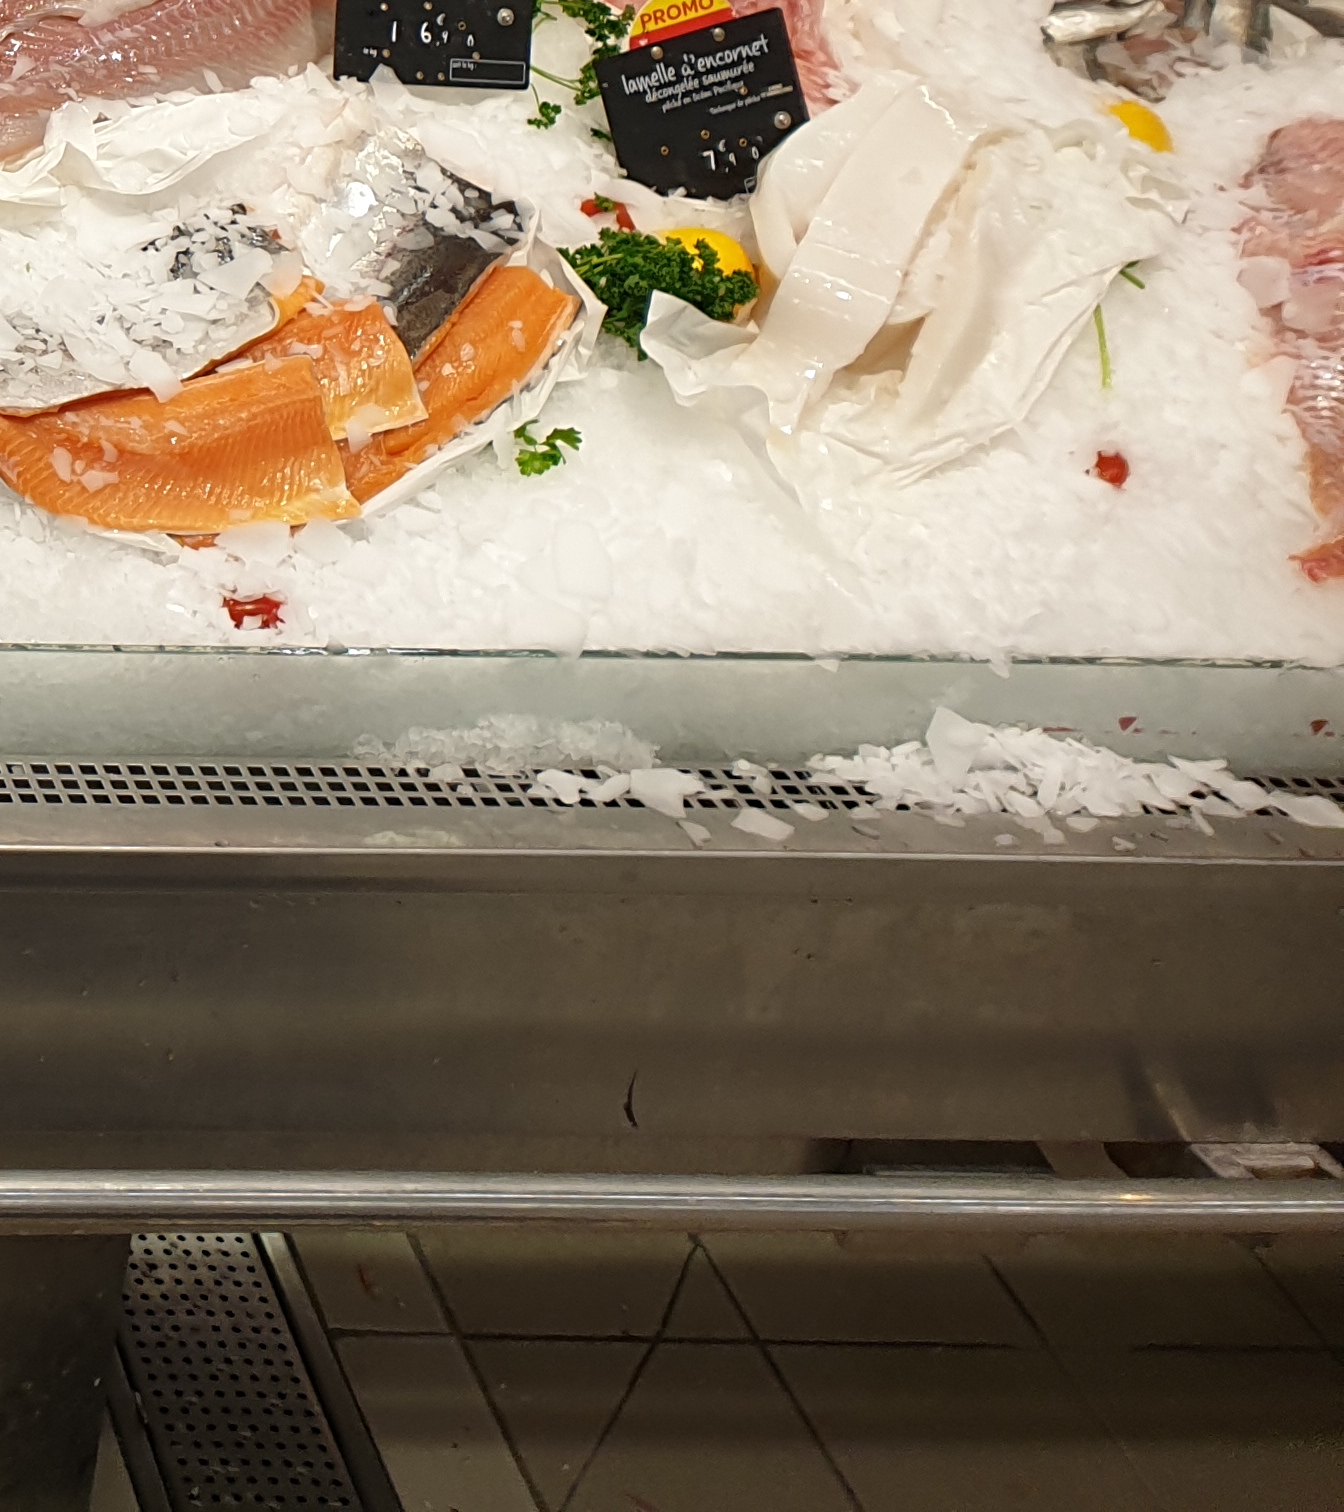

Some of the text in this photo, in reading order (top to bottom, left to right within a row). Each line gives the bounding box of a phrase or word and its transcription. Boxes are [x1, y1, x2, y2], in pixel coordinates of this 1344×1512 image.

[621, 62, 676, 96] lamelle
[645, 59, 755, 105] décongelée saumurée
